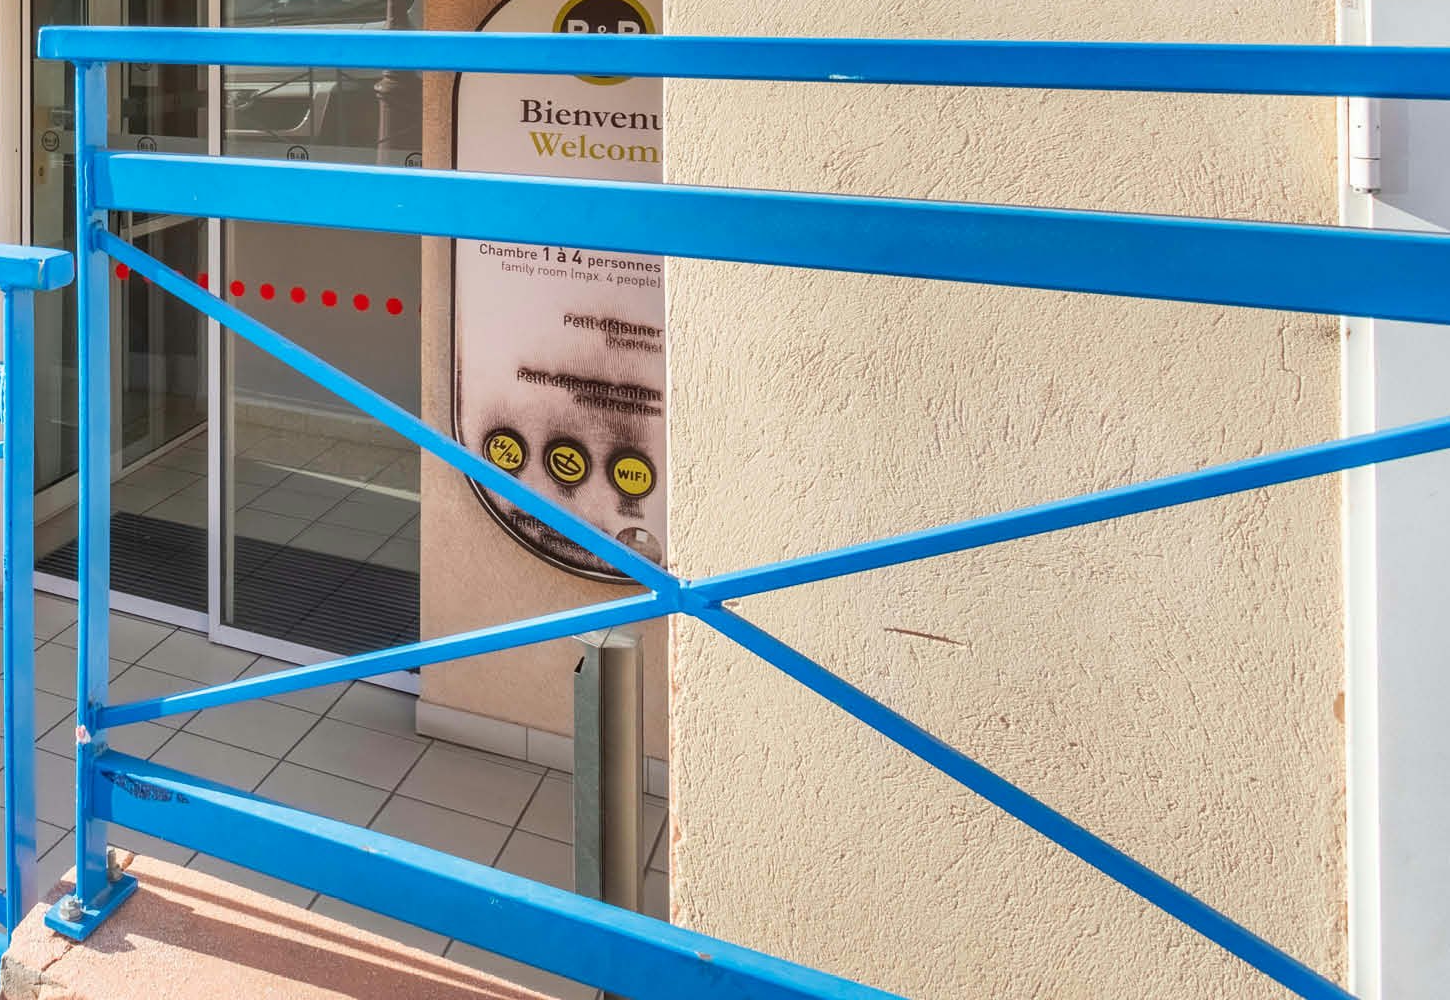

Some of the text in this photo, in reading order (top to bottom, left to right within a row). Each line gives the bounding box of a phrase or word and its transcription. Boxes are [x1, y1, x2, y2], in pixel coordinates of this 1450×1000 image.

[529, 131, 663, 163] Welcom
[479, 243, 538, 260] Chambre
[543, 247, 549, 261] 1
[572, 250, 582, 265] 4
[588, 256, 661, 273] personnes
[501, 261, 535, 275] family
[537, 267, 567, 278] room
[606, 273, 614, 283] 4
[617, 468, 647, 484] WIFI
